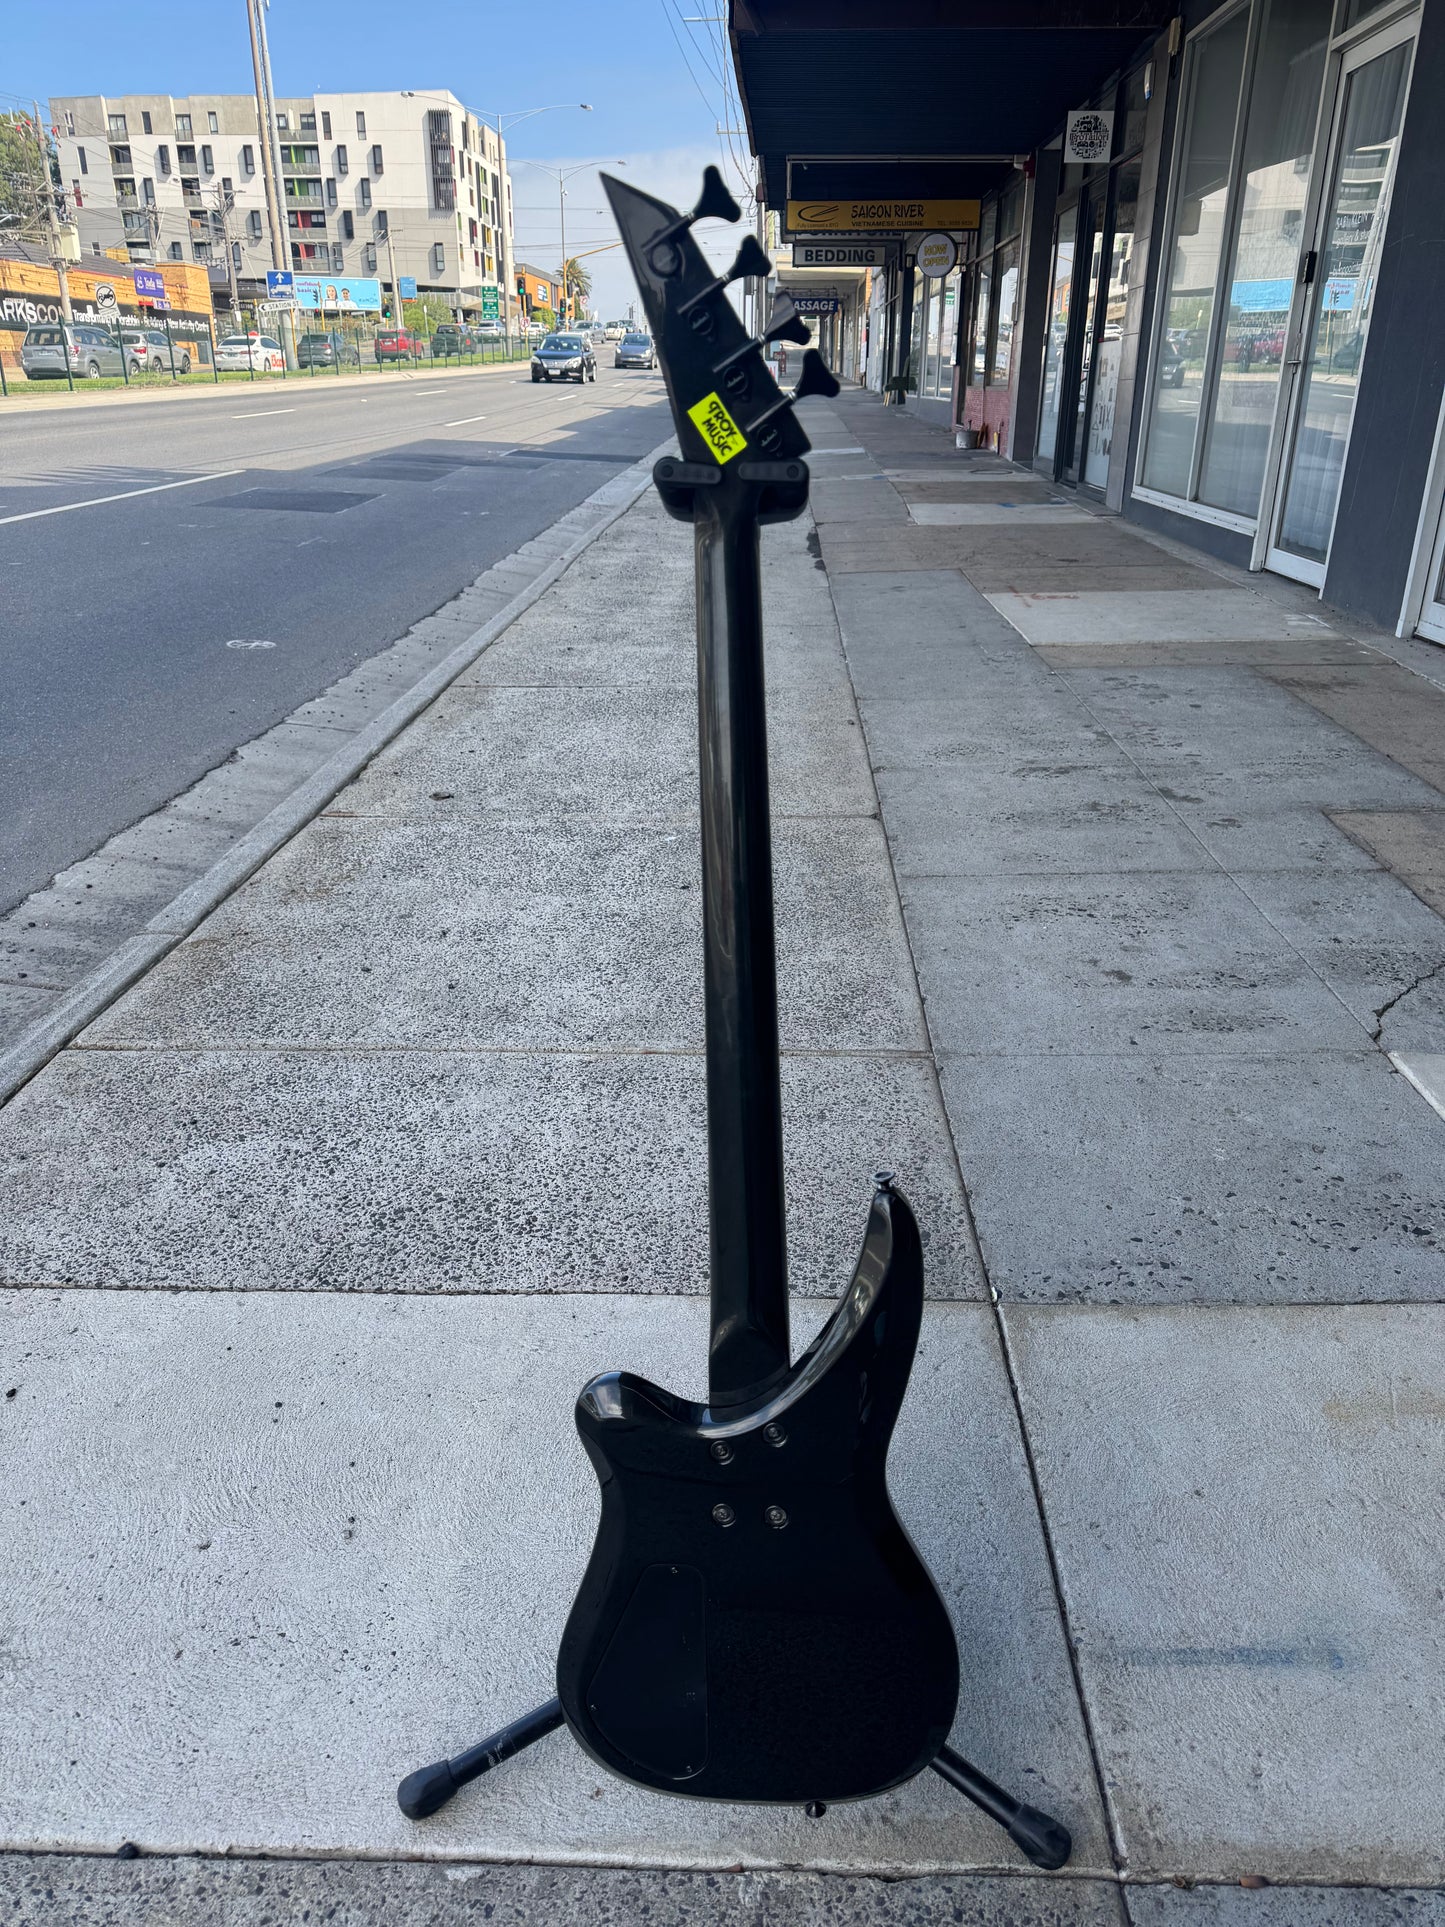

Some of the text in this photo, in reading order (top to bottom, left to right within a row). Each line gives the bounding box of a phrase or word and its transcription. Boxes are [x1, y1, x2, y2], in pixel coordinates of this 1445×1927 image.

[850, 203, 925, 219] SAIGON RIVER
[804, 249, 876, 262] BEDDING
[924, 243, 948, 256] NOW
[922, 256, 949, 267] OPEN
[268, 301, 292, 309] STATION
[794, 300, 835, 311] ASSAGE
[706, 401, 737, 437] TROY
[702, 417, 733, 456] MUSIC
